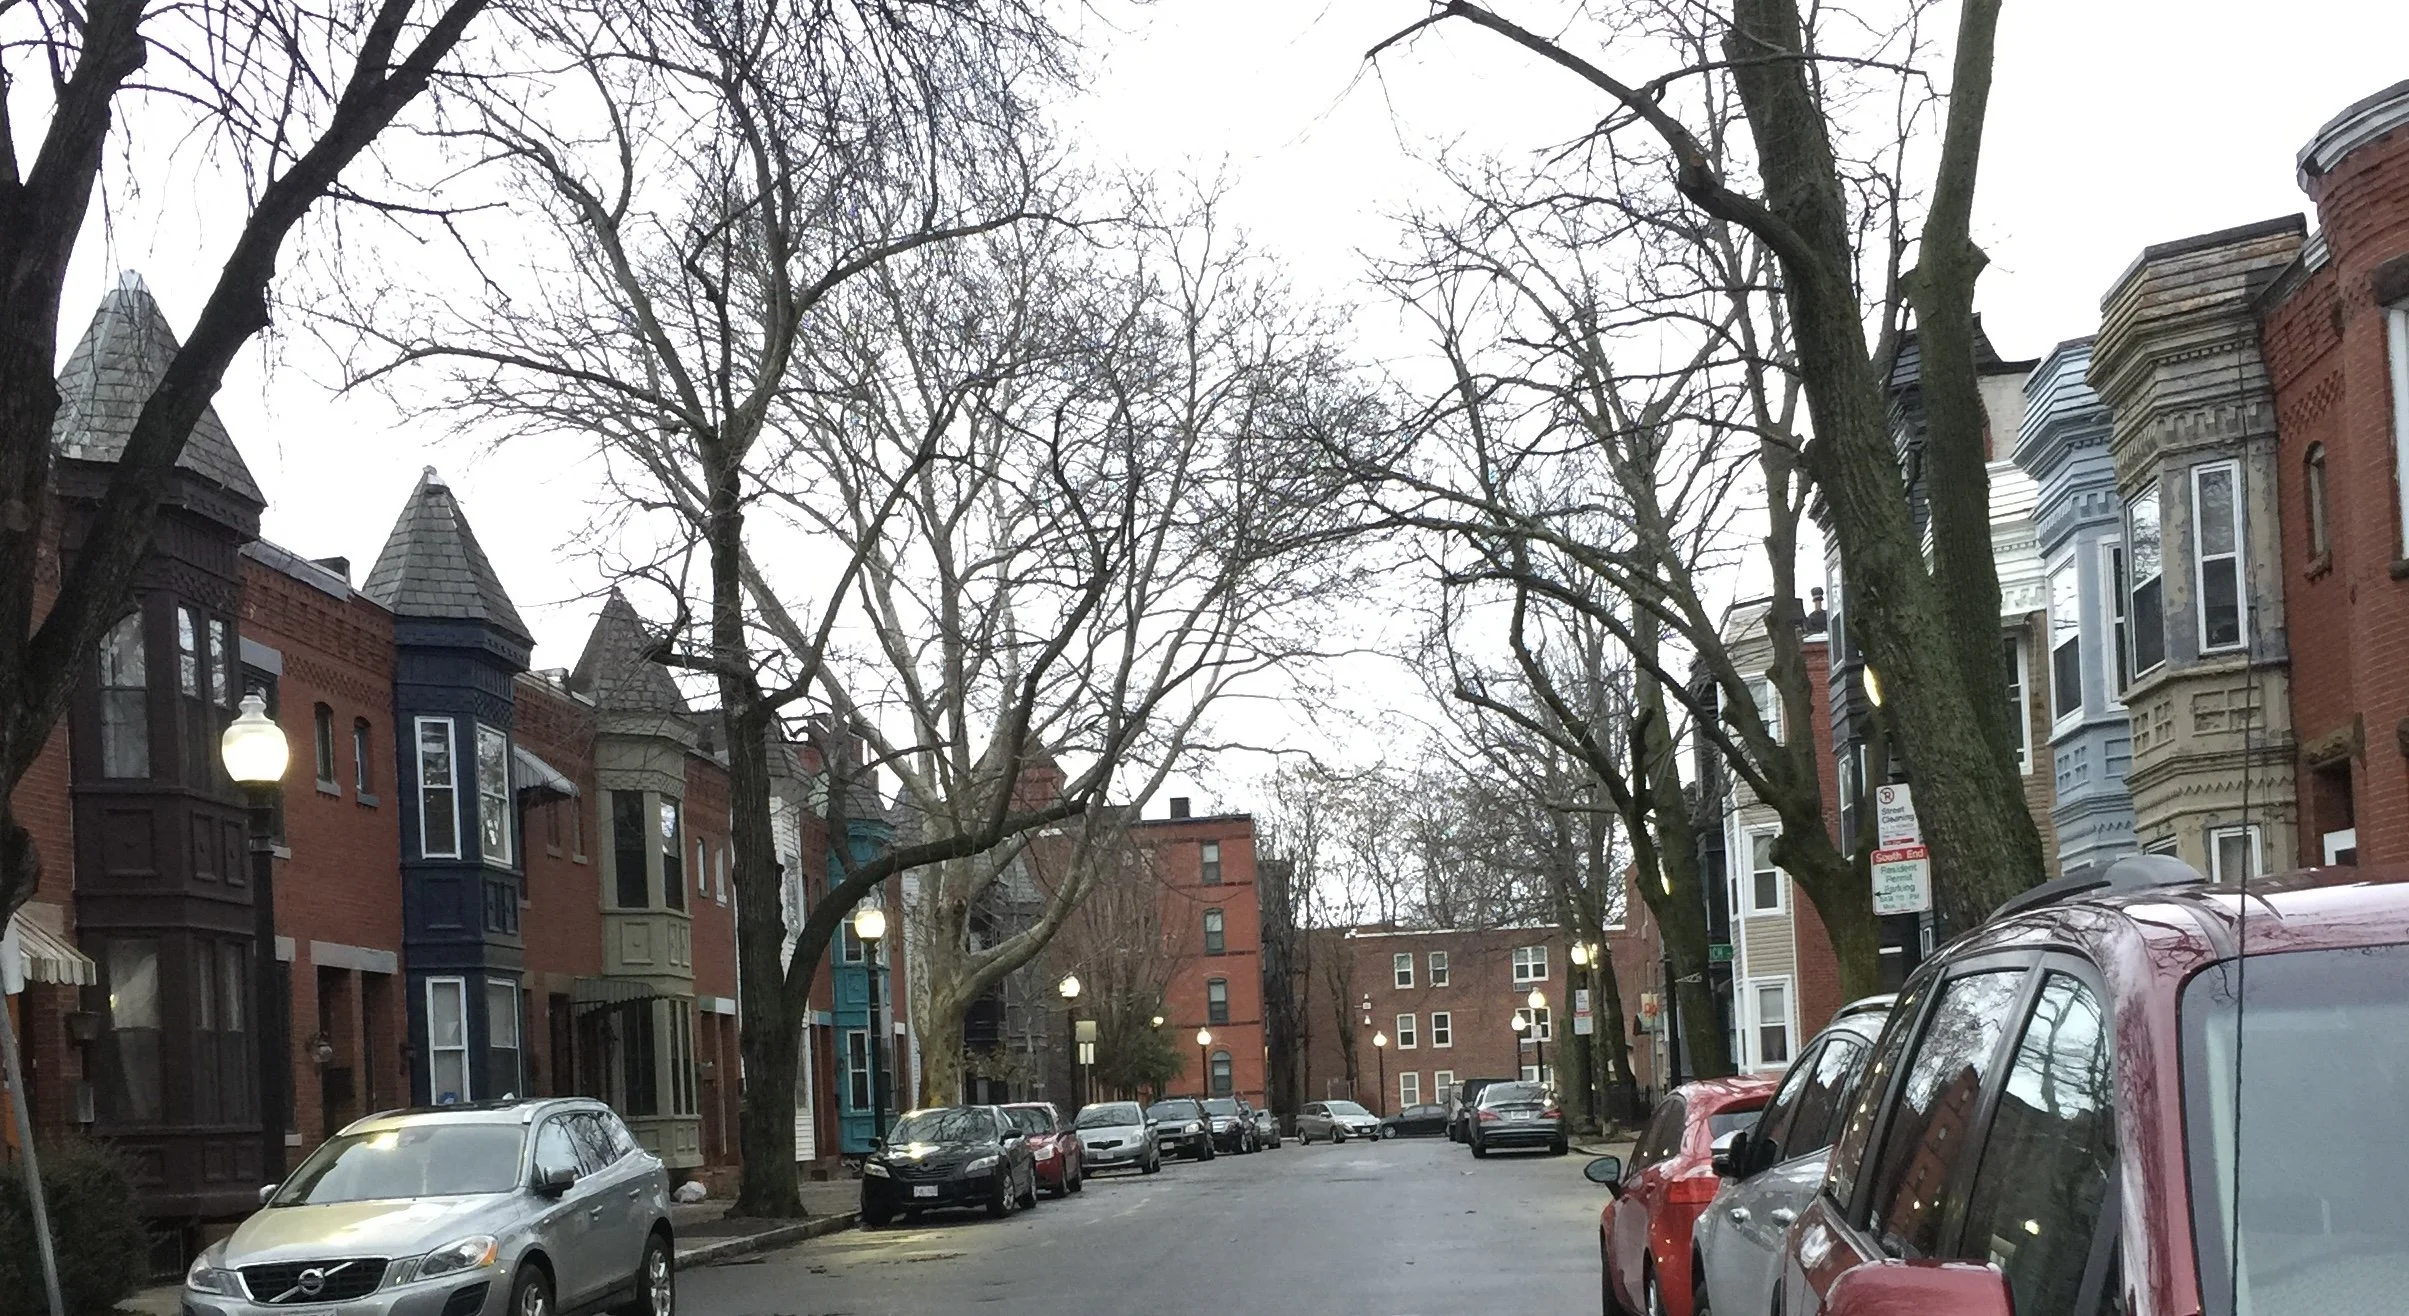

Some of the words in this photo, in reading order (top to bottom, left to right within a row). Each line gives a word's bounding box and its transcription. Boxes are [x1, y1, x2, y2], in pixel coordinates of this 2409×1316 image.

[1881, 806, 1905, 815] Street
[1881, 814, 1915, 824] Cleaning
[1875, 851, 1903, 863] South
[1906, 848, 1924, 859] End
[1880, 864, 1918, 875] Resident
[1885, 873, 1913, 883] Permit
[1884, 884, 1916, 893] Parking
